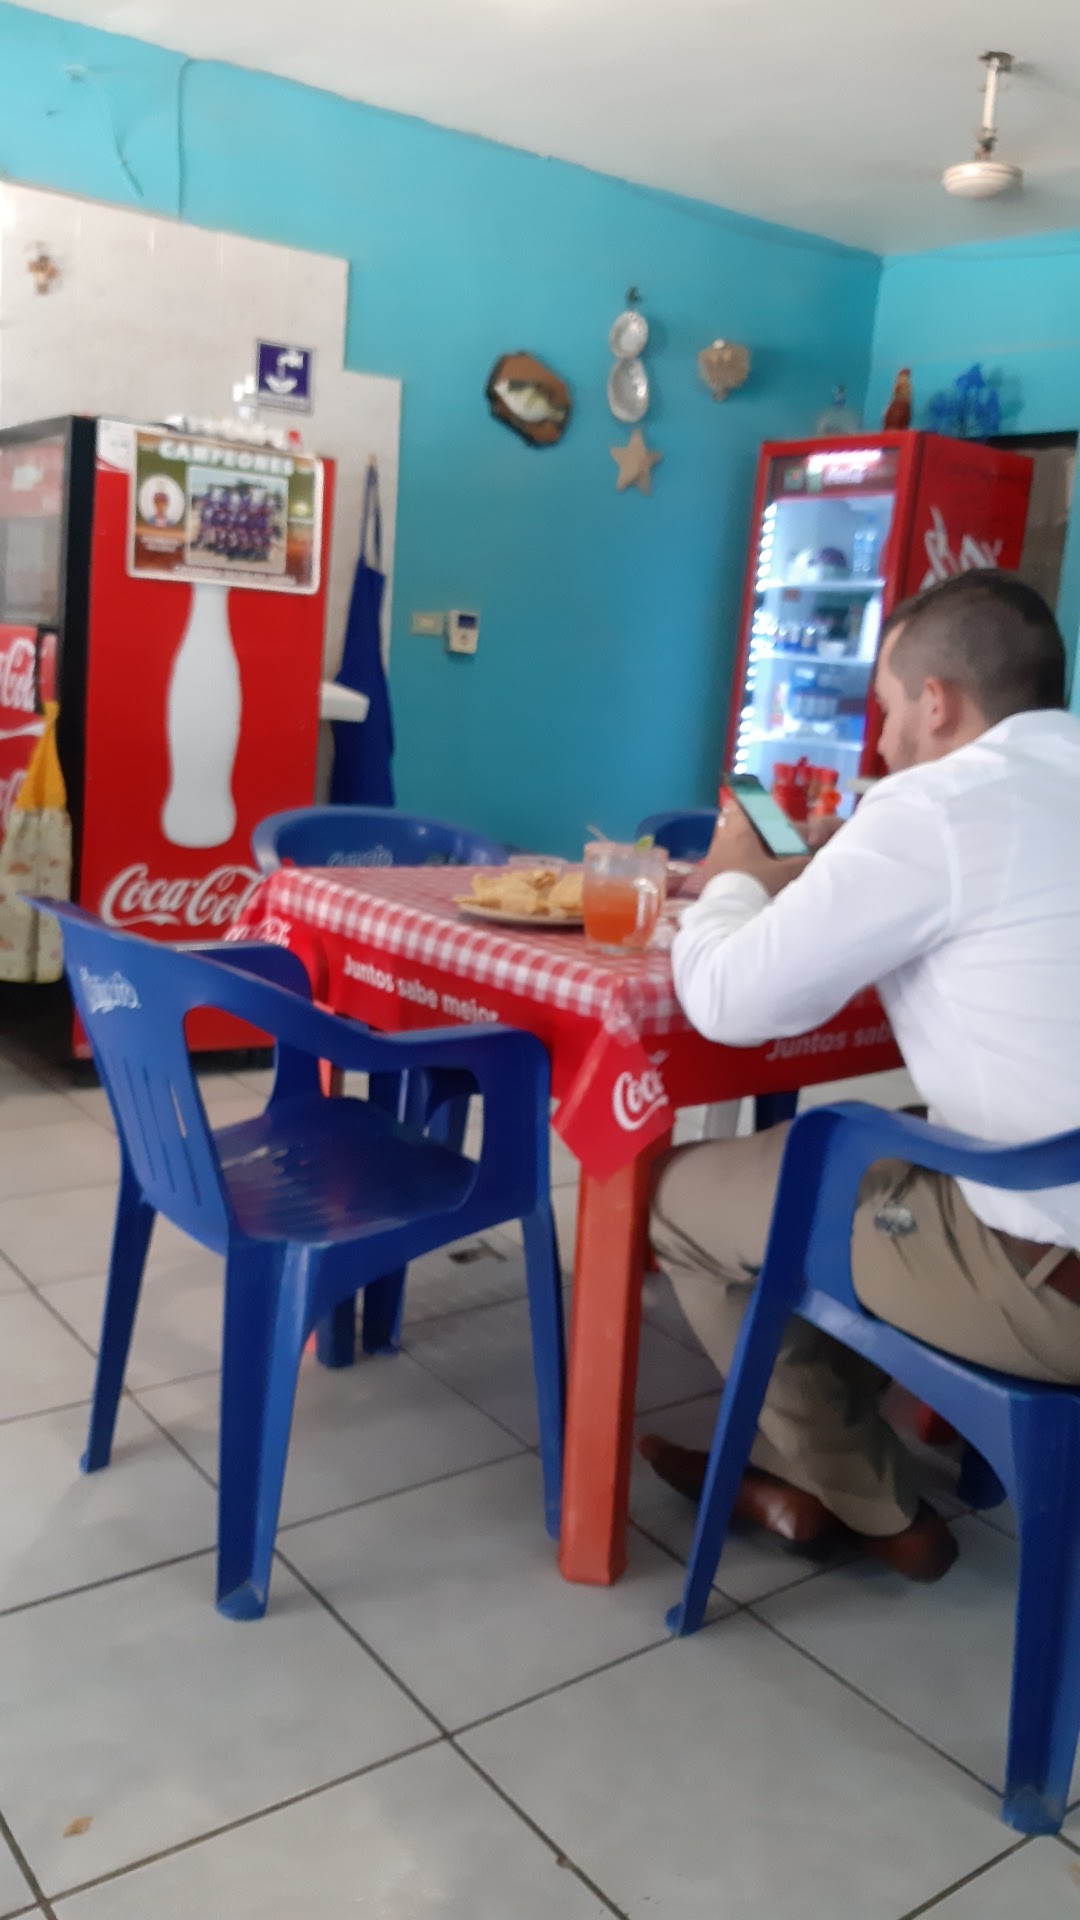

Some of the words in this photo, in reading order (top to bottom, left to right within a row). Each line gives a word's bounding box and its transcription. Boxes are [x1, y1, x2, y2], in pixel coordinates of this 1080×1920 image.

[159, 440, 295, 476] CAMPEONES
[101, 863, 264, 927] Coca-Col
[344, 954, 394, 993] Juntos
[397, 977, 438, 1010] sabe
[441, 993, 498, 1023] mejor
[765, 1031, 847, 1060] Juntos
[853, 1020, 891, 1047] sab
